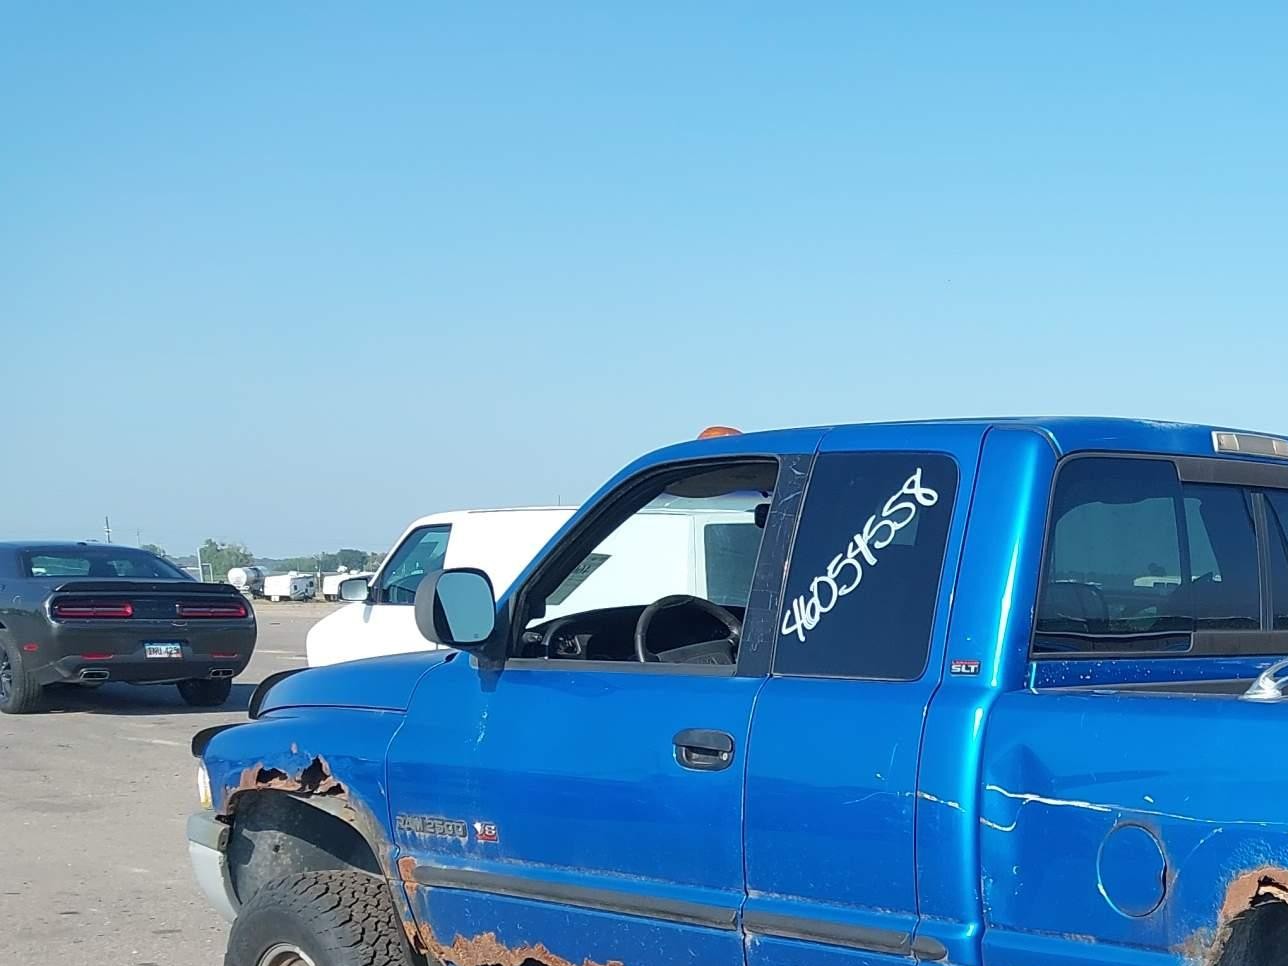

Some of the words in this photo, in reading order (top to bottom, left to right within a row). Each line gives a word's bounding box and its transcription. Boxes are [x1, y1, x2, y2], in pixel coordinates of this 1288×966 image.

[781, 467, 939, 642] 46054558
[951, 664, 978, 673] SLT
[396, 815, 424, 832] RAM
[425, 819, 466, 837] 2500
